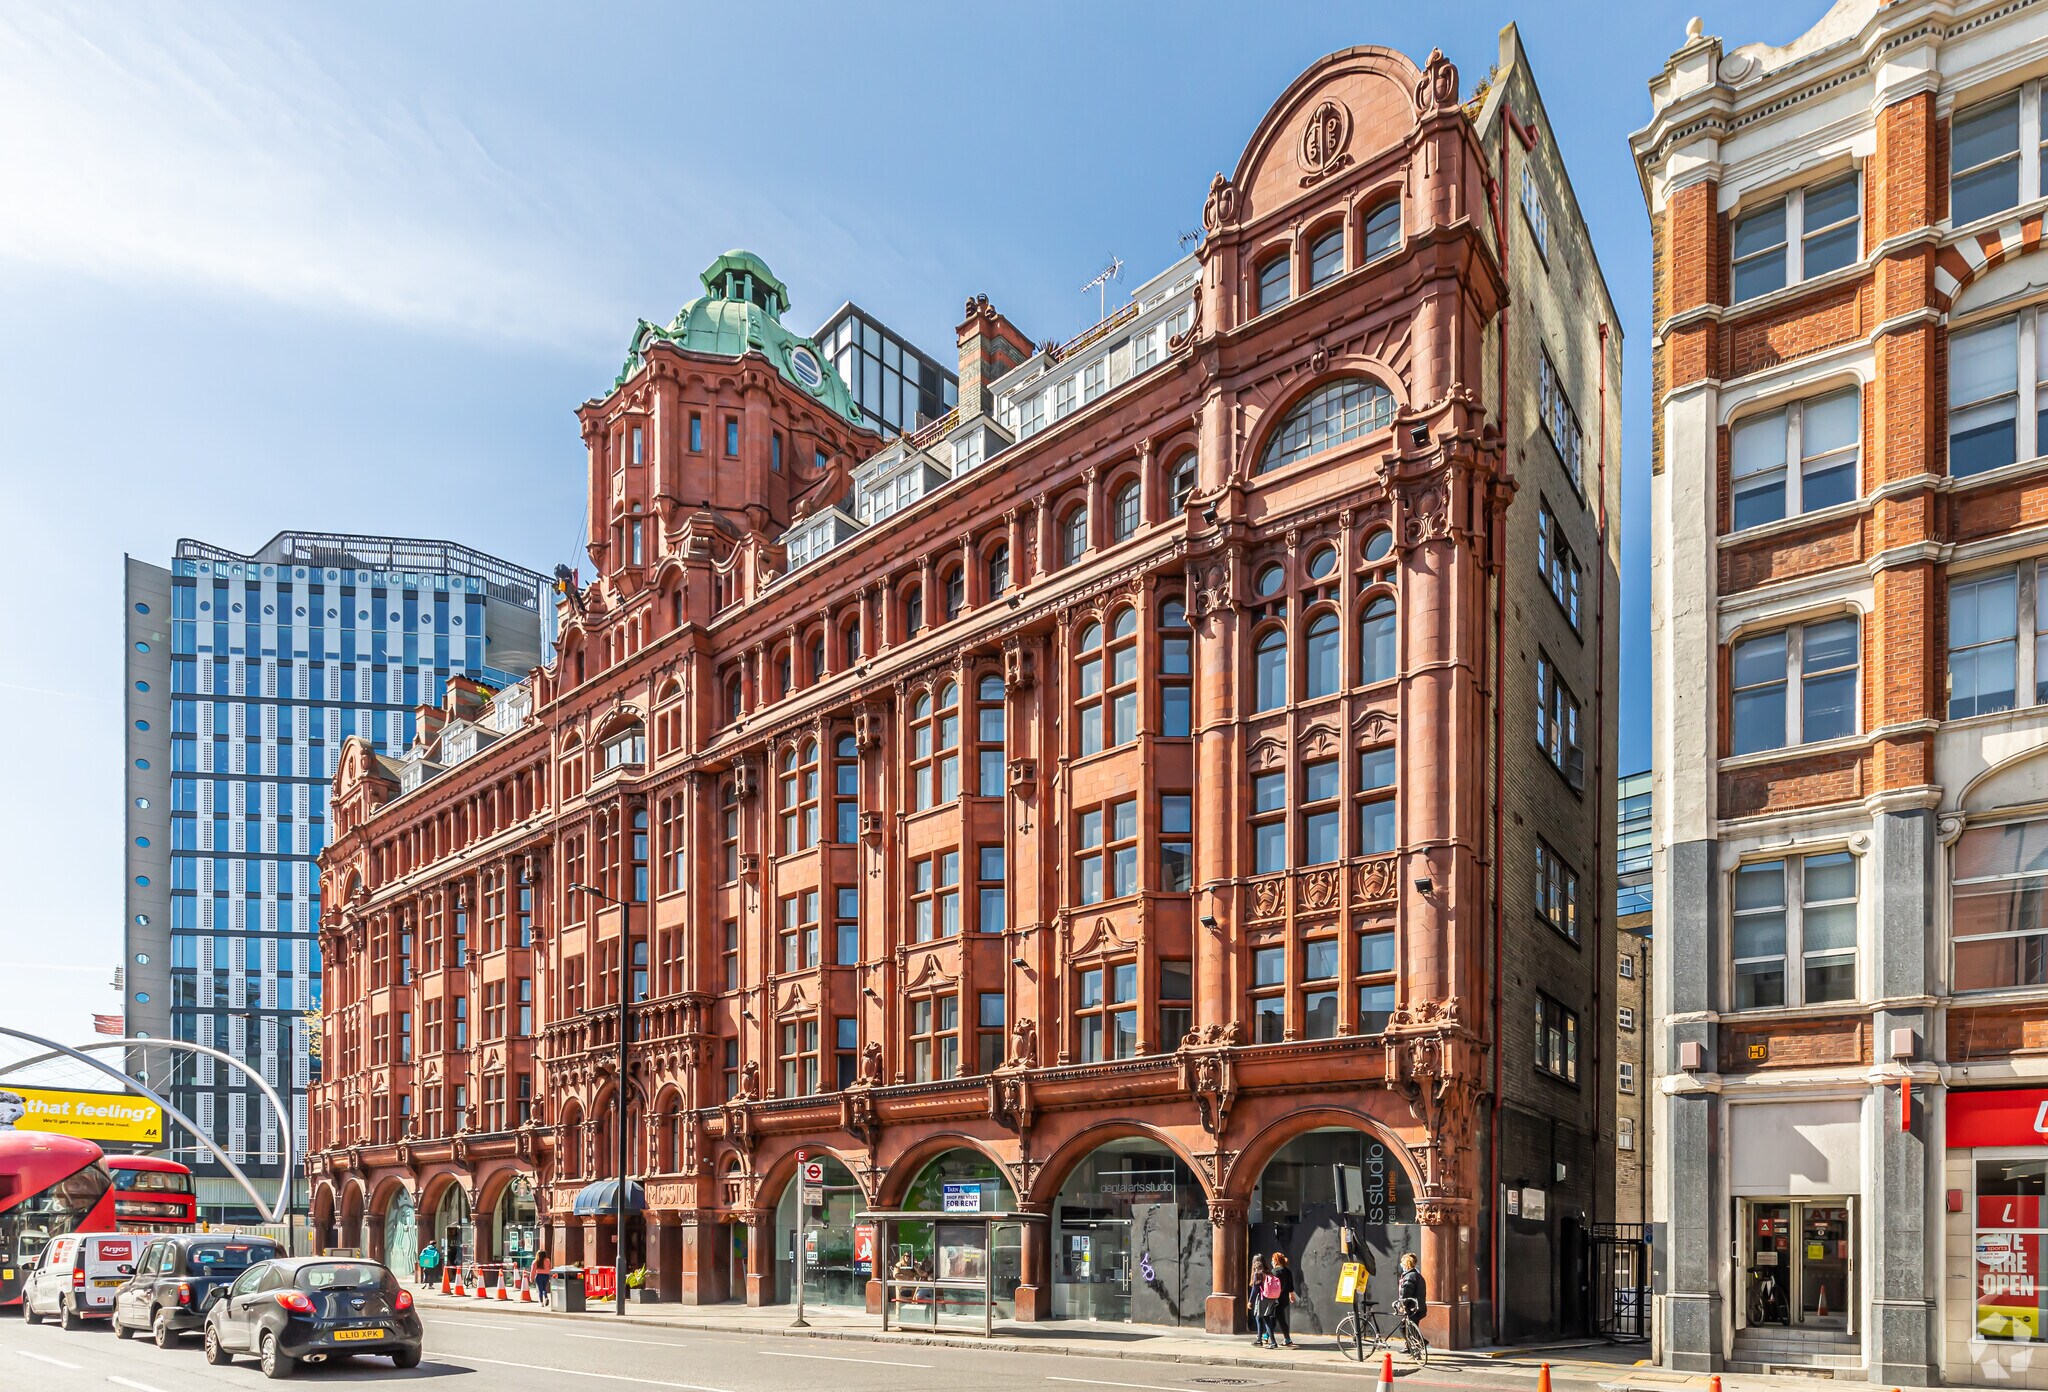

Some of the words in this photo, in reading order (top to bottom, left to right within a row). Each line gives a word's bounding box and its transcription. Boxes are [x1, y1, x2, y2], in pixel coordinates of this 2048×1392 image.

[27, 1099, 71, 1115] that
[75, 1101, 156, 1123] feeling?
[798, 1152, 805, 1161] E
[1366, 1143, 1384, 1205] studio
[647, 1183, 696, 1205] MISSION
[1100, 1182, 1128, 1194] dental
[1128, 1182, 1145, 1193] arts
[1145, 1181, 1173, 1192] studio
[1388, 1170, 1397, 1203] smiles
[43, 1199, 62, 1212] 76
[101, 1245, 129, 1254] Argos
[1982, 1275, 2035, 1297] OPEN
[361, 1330, 379, 1338] XPK
